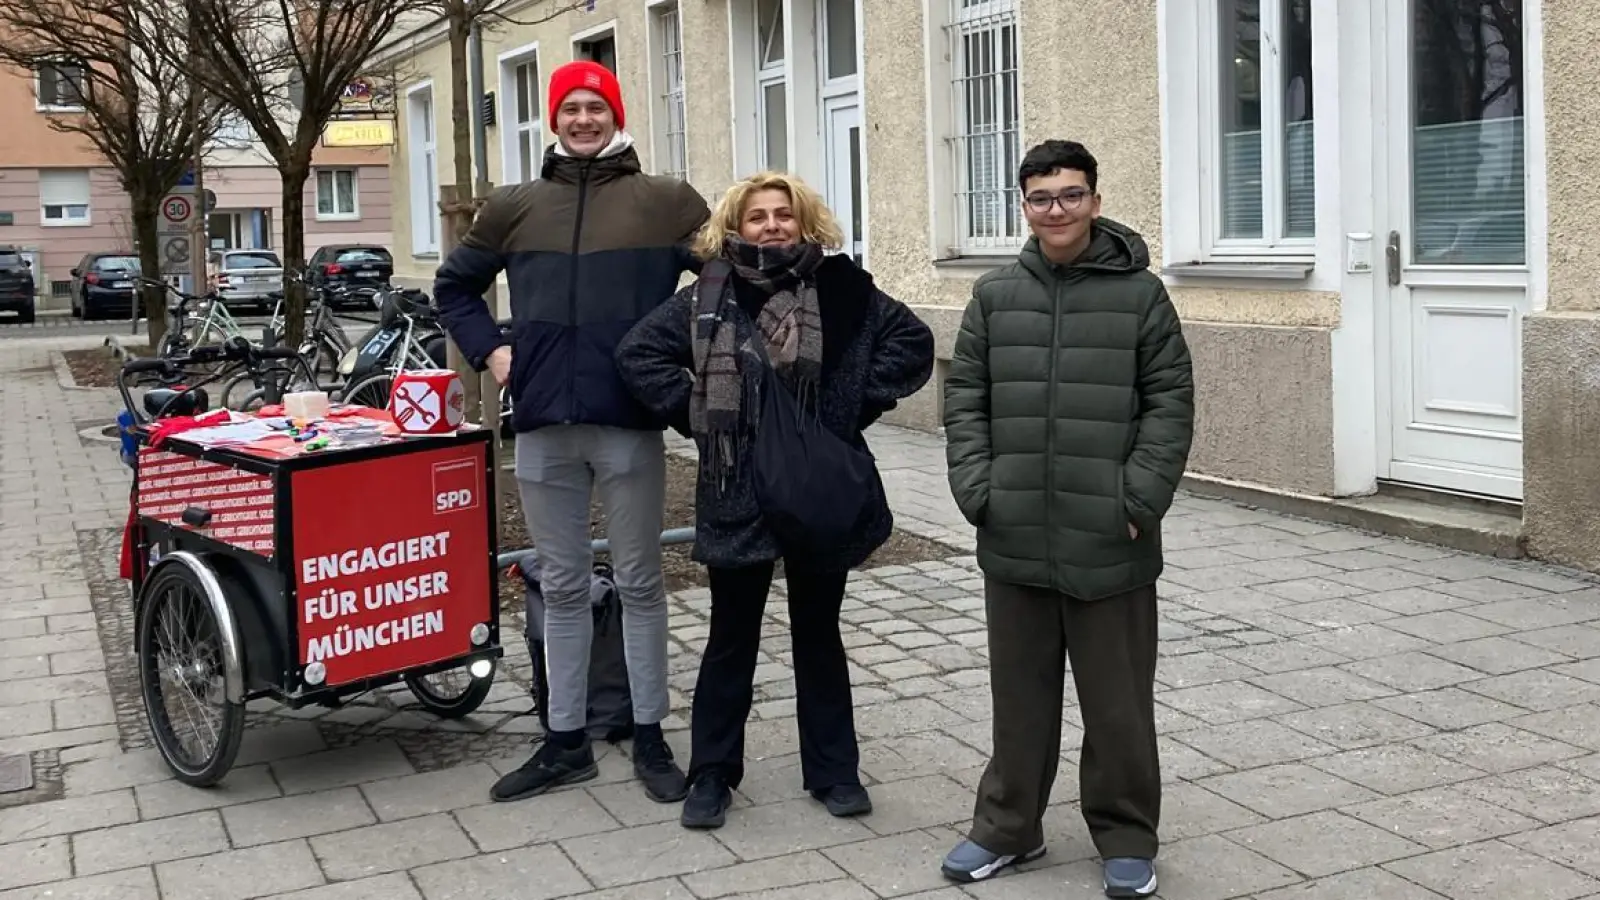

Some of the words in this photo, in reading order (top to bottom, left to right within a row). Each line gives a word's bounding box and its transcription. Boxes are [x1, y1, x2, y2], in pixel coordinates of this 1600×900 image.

[168, 203, 185, 216] 30
[436, 488, 472, 511] SPD
[302, 531, 450, 584] ENGAGIERT
[304, 588, 359, 624] FÜR
[364, 571, 449, 610] UNSER
[306, 609, 445, 664] MÜNCHEN
